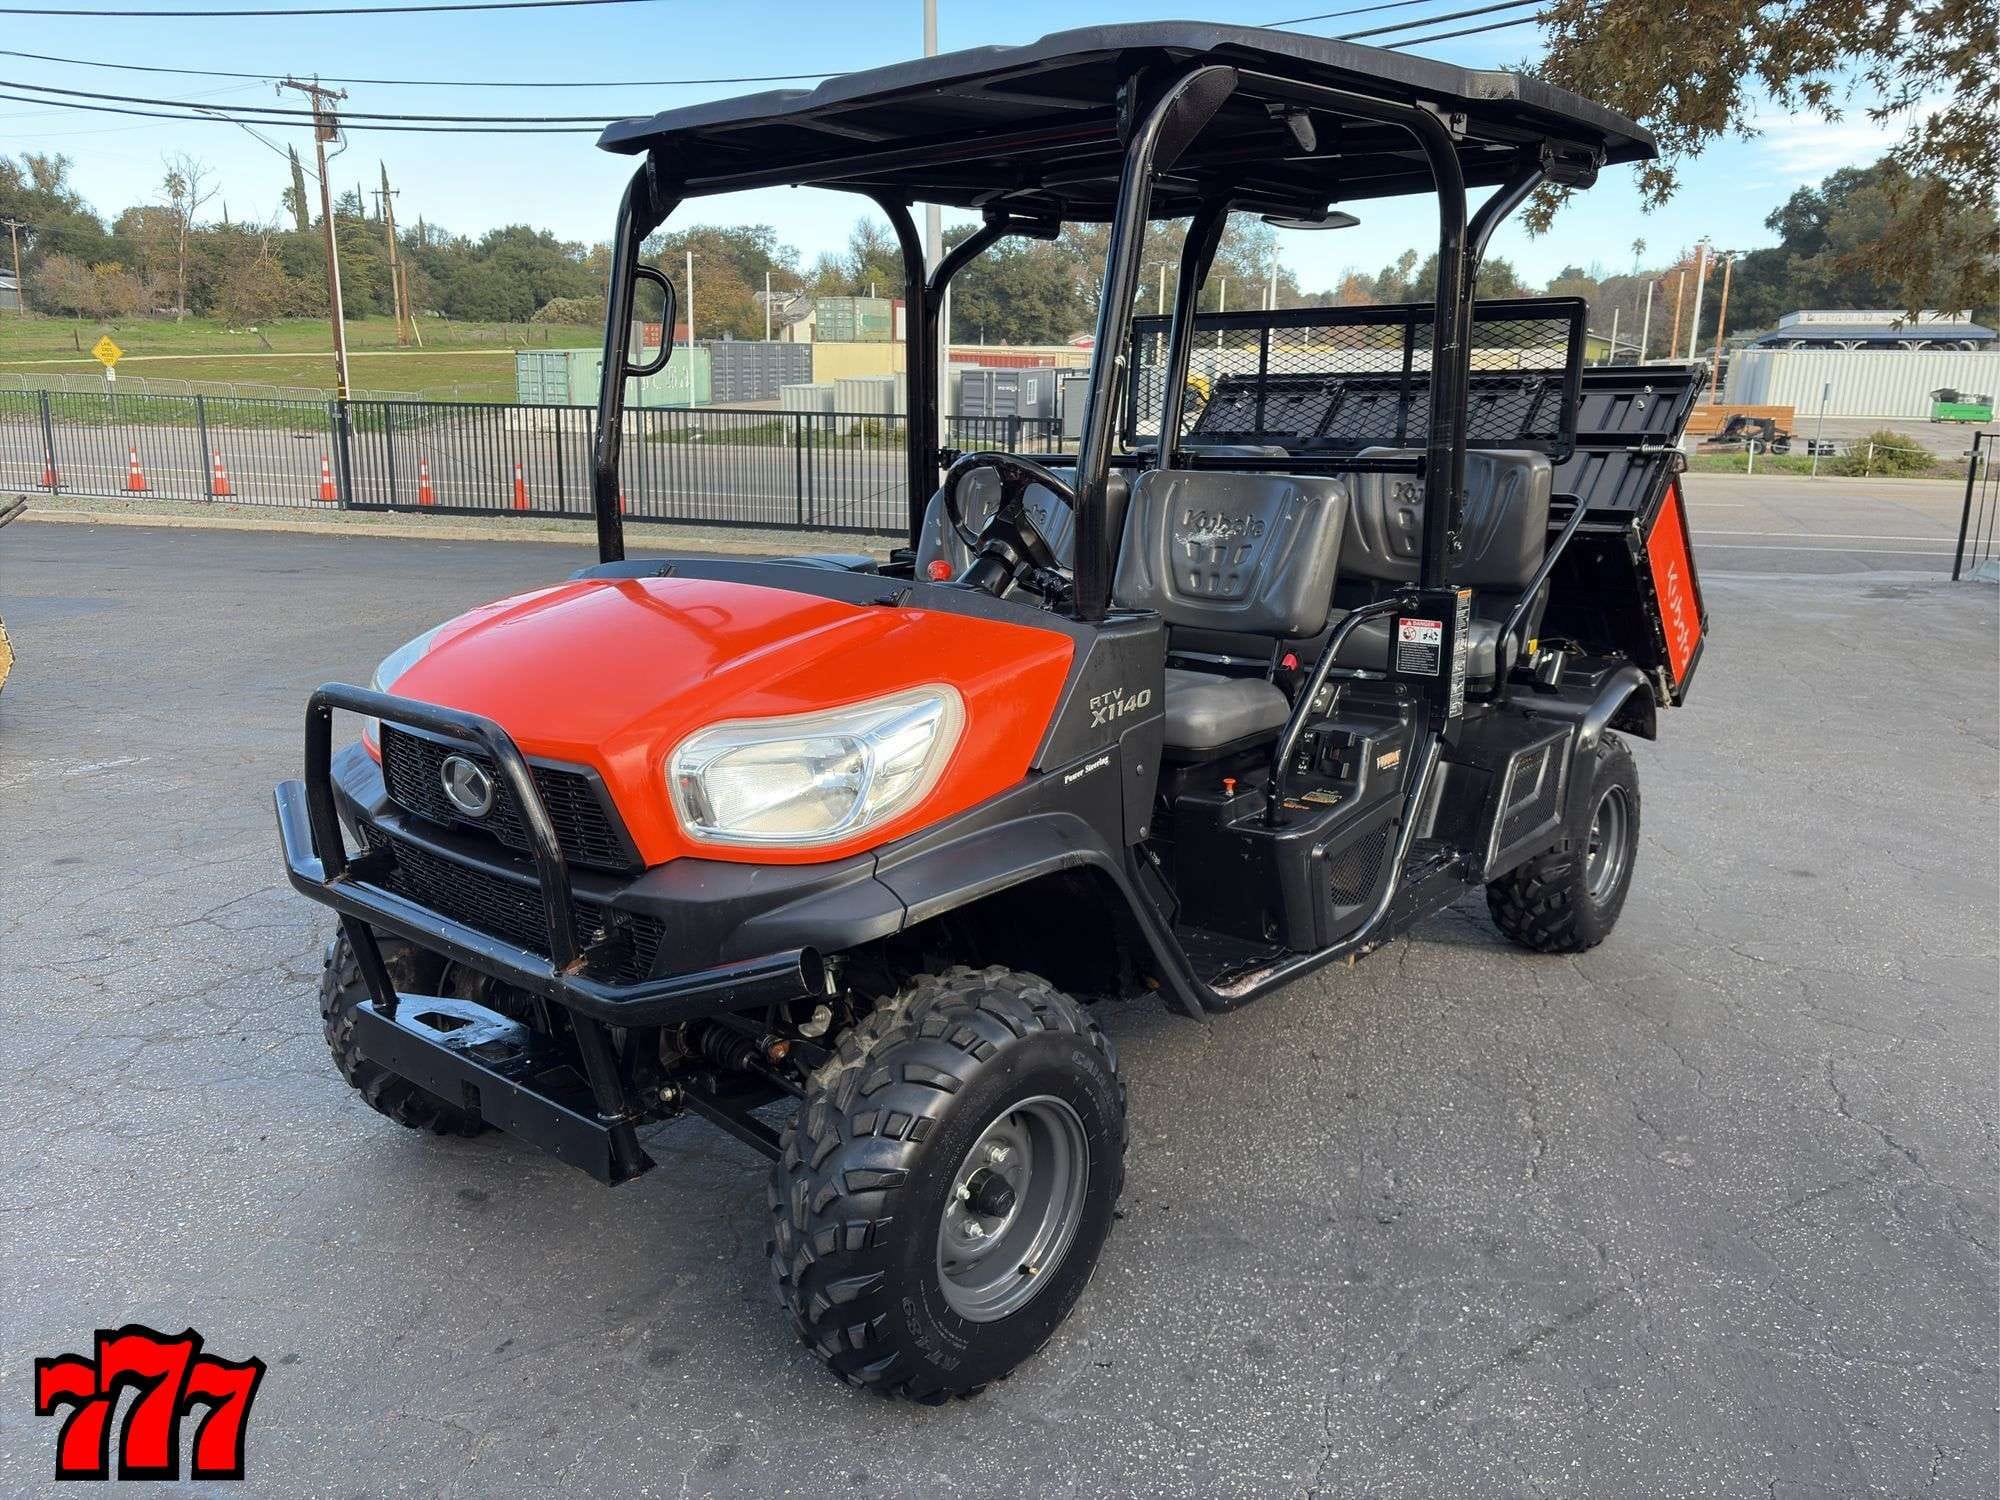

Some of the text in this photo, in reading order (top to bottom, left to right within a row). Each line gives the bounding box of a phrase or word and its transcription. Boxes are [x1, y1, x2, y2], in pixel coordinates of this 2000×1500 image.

[1667, 560, 1691, 669] Kubota
[1089, 687, 1123, 710] RTV
[1090, 688, 1152, 729] X1140
[1064, 755, 1110, 785] Power Steering
